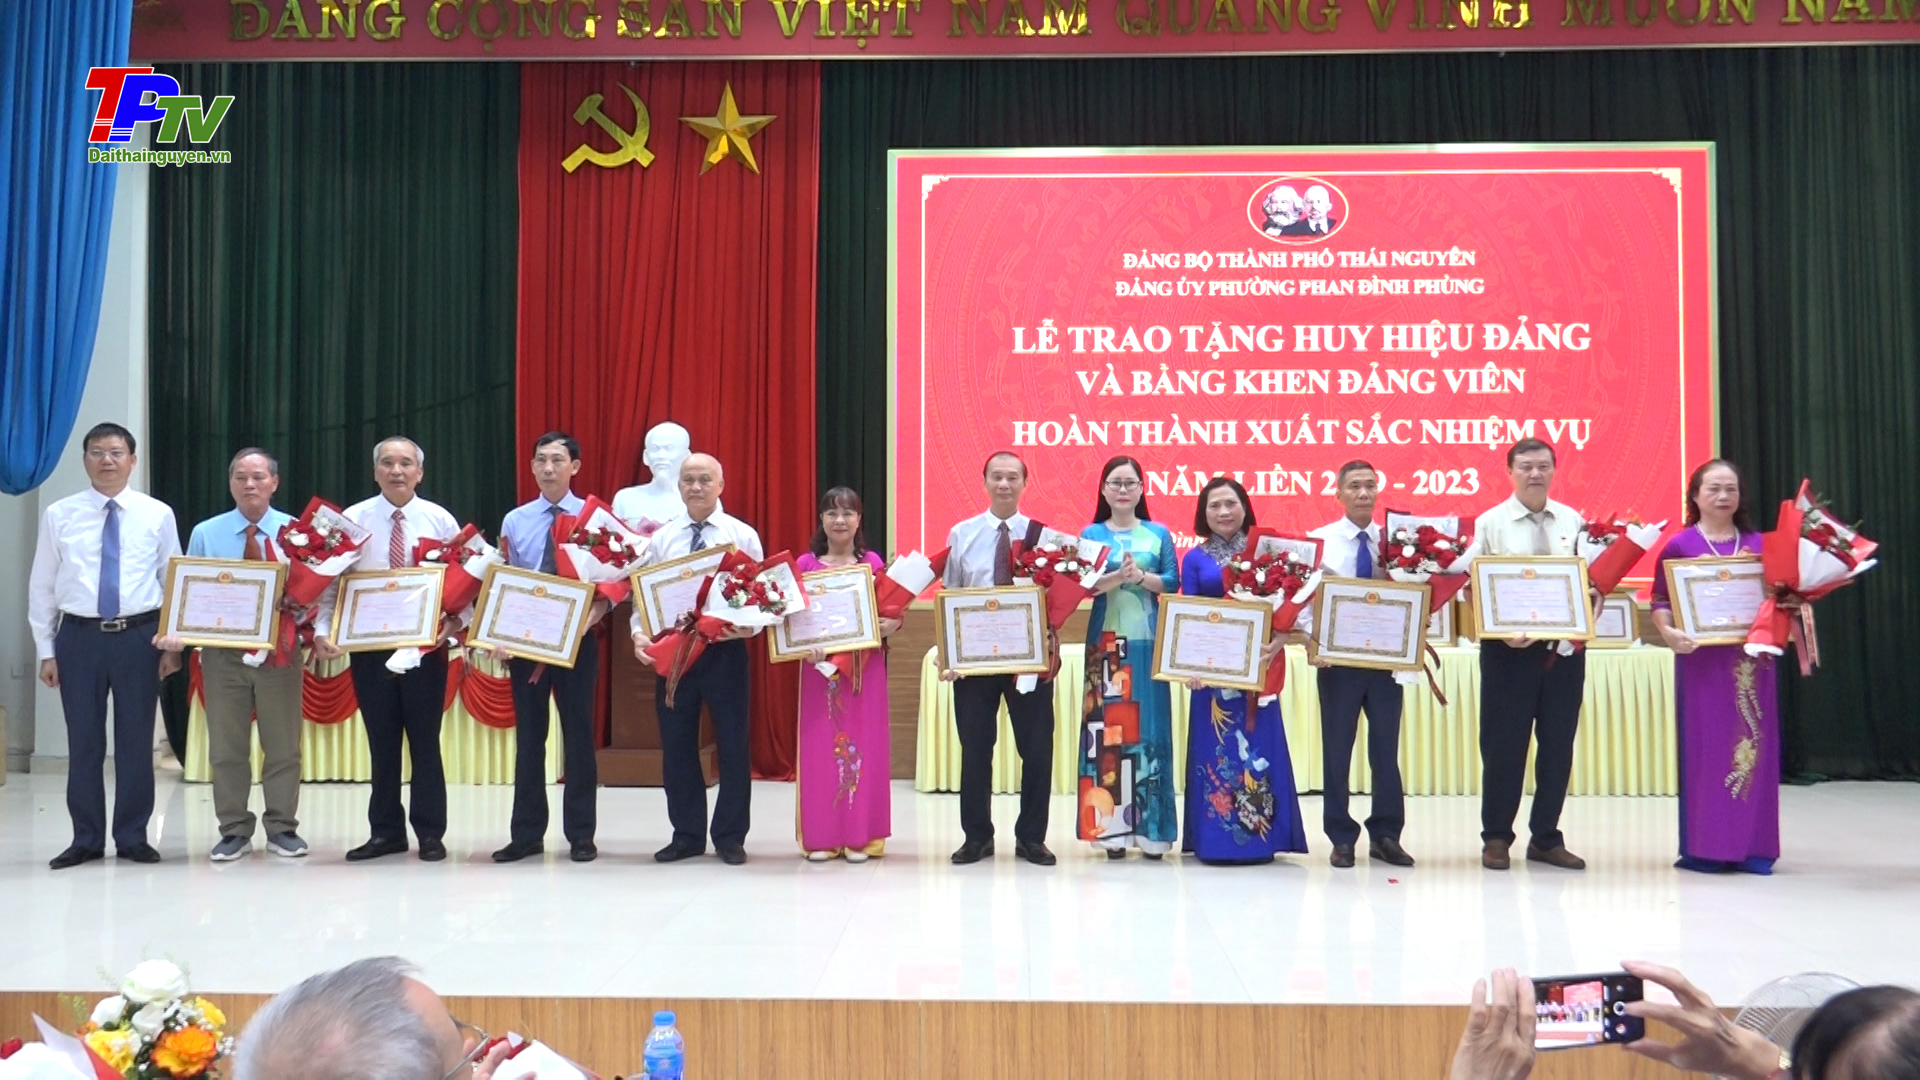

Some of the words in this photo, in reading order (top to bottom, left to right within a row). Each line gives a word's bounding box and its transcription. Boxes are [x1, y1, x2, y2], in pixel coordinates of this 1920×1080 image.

[945, 0, 1093, 37] NAM
[1115, 0, 1343, 36] QUANG
[1366, 0, 1536, 30] VINH
[1123, 248, 1180, 269] ĐẢNG
[1184, 250, 1213, 272] BỘ
[1216, 247, 1288, 269] THÀNH
[1291, 247, 1335, 268] PHỐ
[1337, 247, 1387, 268] THÁI
[1391, 246, 1476, 267] NGUYÊN
[1115, 276, 1173, 297] ĐẢNG
[1176, 275, 1205, 296] ỦY
[1208, 275, 1295, 296] PHƯỜNG
[1299, 279, 1354, 296] PHAN
[1358, 274, 1409, 295] ĐÌNH
[1413, 274, 1485, 295] PHÙNG
[1012, 318, 1059, 354] LỄ
[1067, 325, 1172, 354] TRAO
[1179, 321, 1285, 360] TẶNG
[1293, 324, 1375, 352] HUY
[1381, 319, 1474, 359] HIỆU
[1482, 315, 1592, 351] ĐẢNG
[1075, 363, 1124, 396] VÀ
[1130, 363, 1226, 396] BẰNG
[1233, 369, 1331, 395] KHEN
[1337, 361, 1437, 394] ĐẢNG
[1443, 361, 1526, 394] VIÊN
[1012, 413, 1110, 446] HOÀN
[1117, 413, 1238, 446] THÀNH
[1245, 413, 1339, 445] XUẤT
[1346, 412, 1412, 445] SẮC
[1420, 415, 1537, 451] NHIỆM
[1543, 419, 1592, 451] VỤ
[1232, 463, 1313, 496] LIỀN
[1320, 469, 1387, 496] 29
[1412, 467, 1480, 496] 2023
